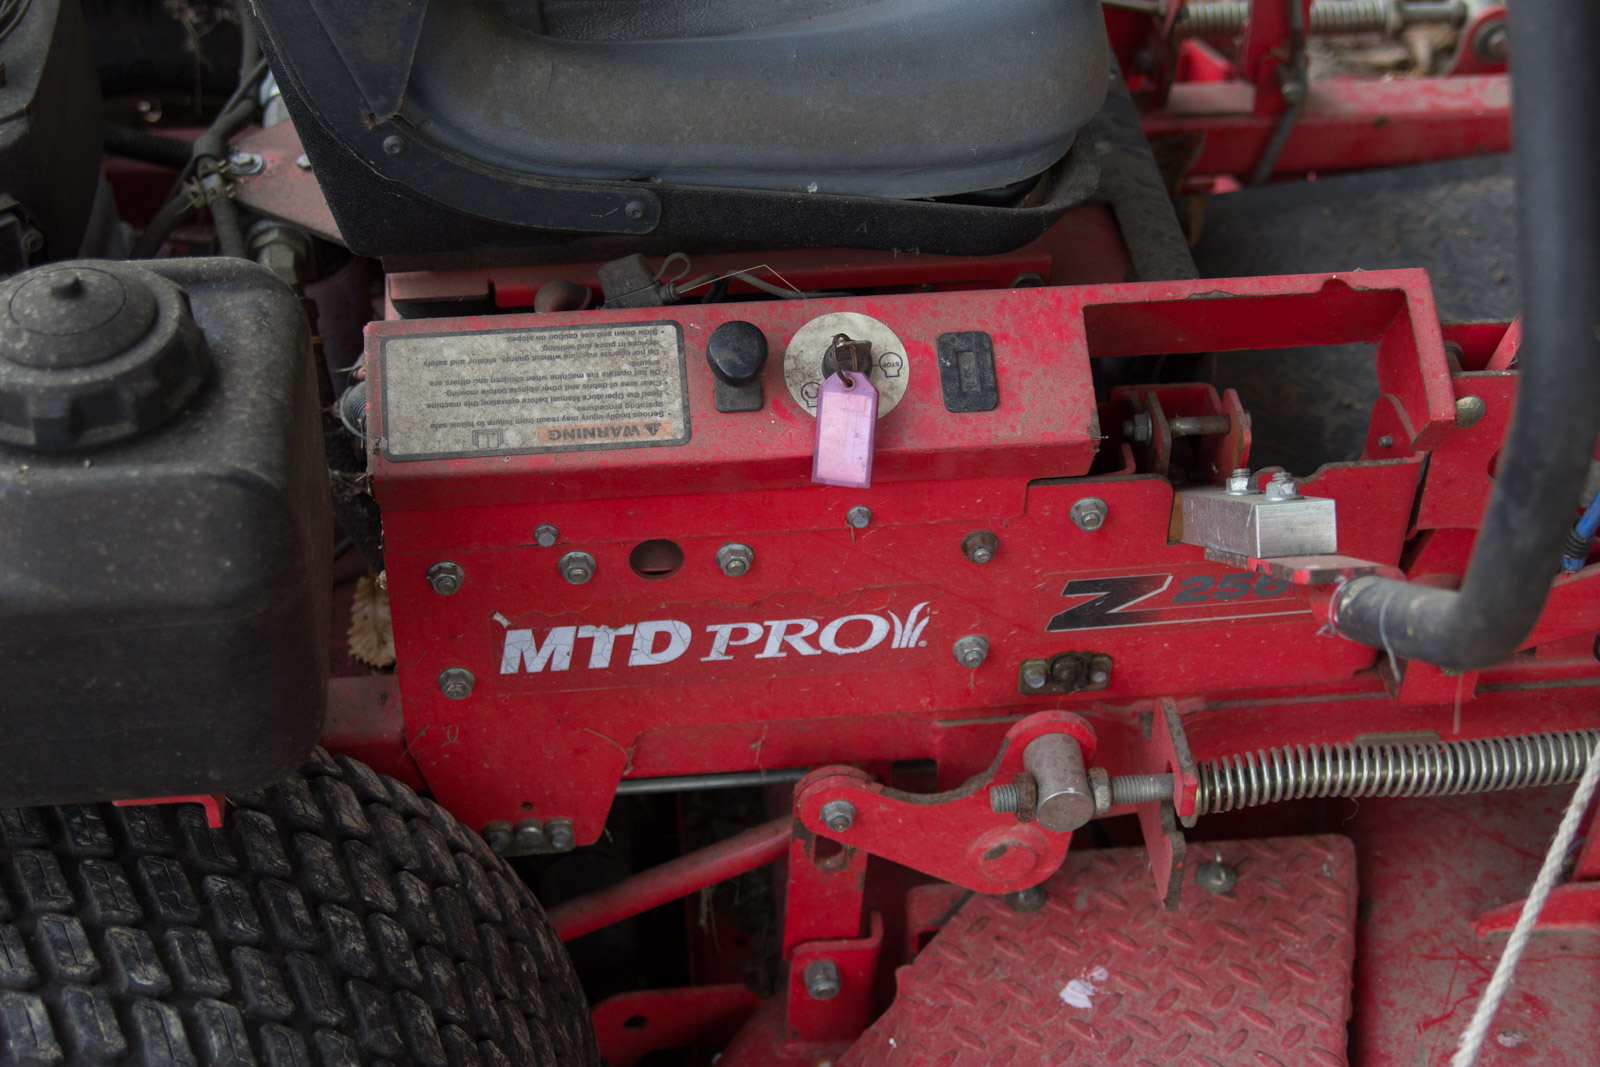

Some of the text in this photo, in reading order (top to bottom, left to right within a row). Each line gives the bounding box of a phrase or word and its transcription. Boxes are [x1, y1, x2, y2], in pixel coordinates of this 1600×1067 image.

[599, 349, 629, 357] operate
[423, 358, 447, 366] safety
[601, 369, 631, 377] operate
[510, 385, 538, 394] objects
[480, 397, 519, 406] operating
[624, 400, 663, 410] operating
[581, 412, 603, 421] injury
[606, 411, 630, 420] bodily
[547, 424, 640, 440] WARNING
[1045, 572, 1290, 632] Z 256
[500, 613, 890, 675] MTD PRO
